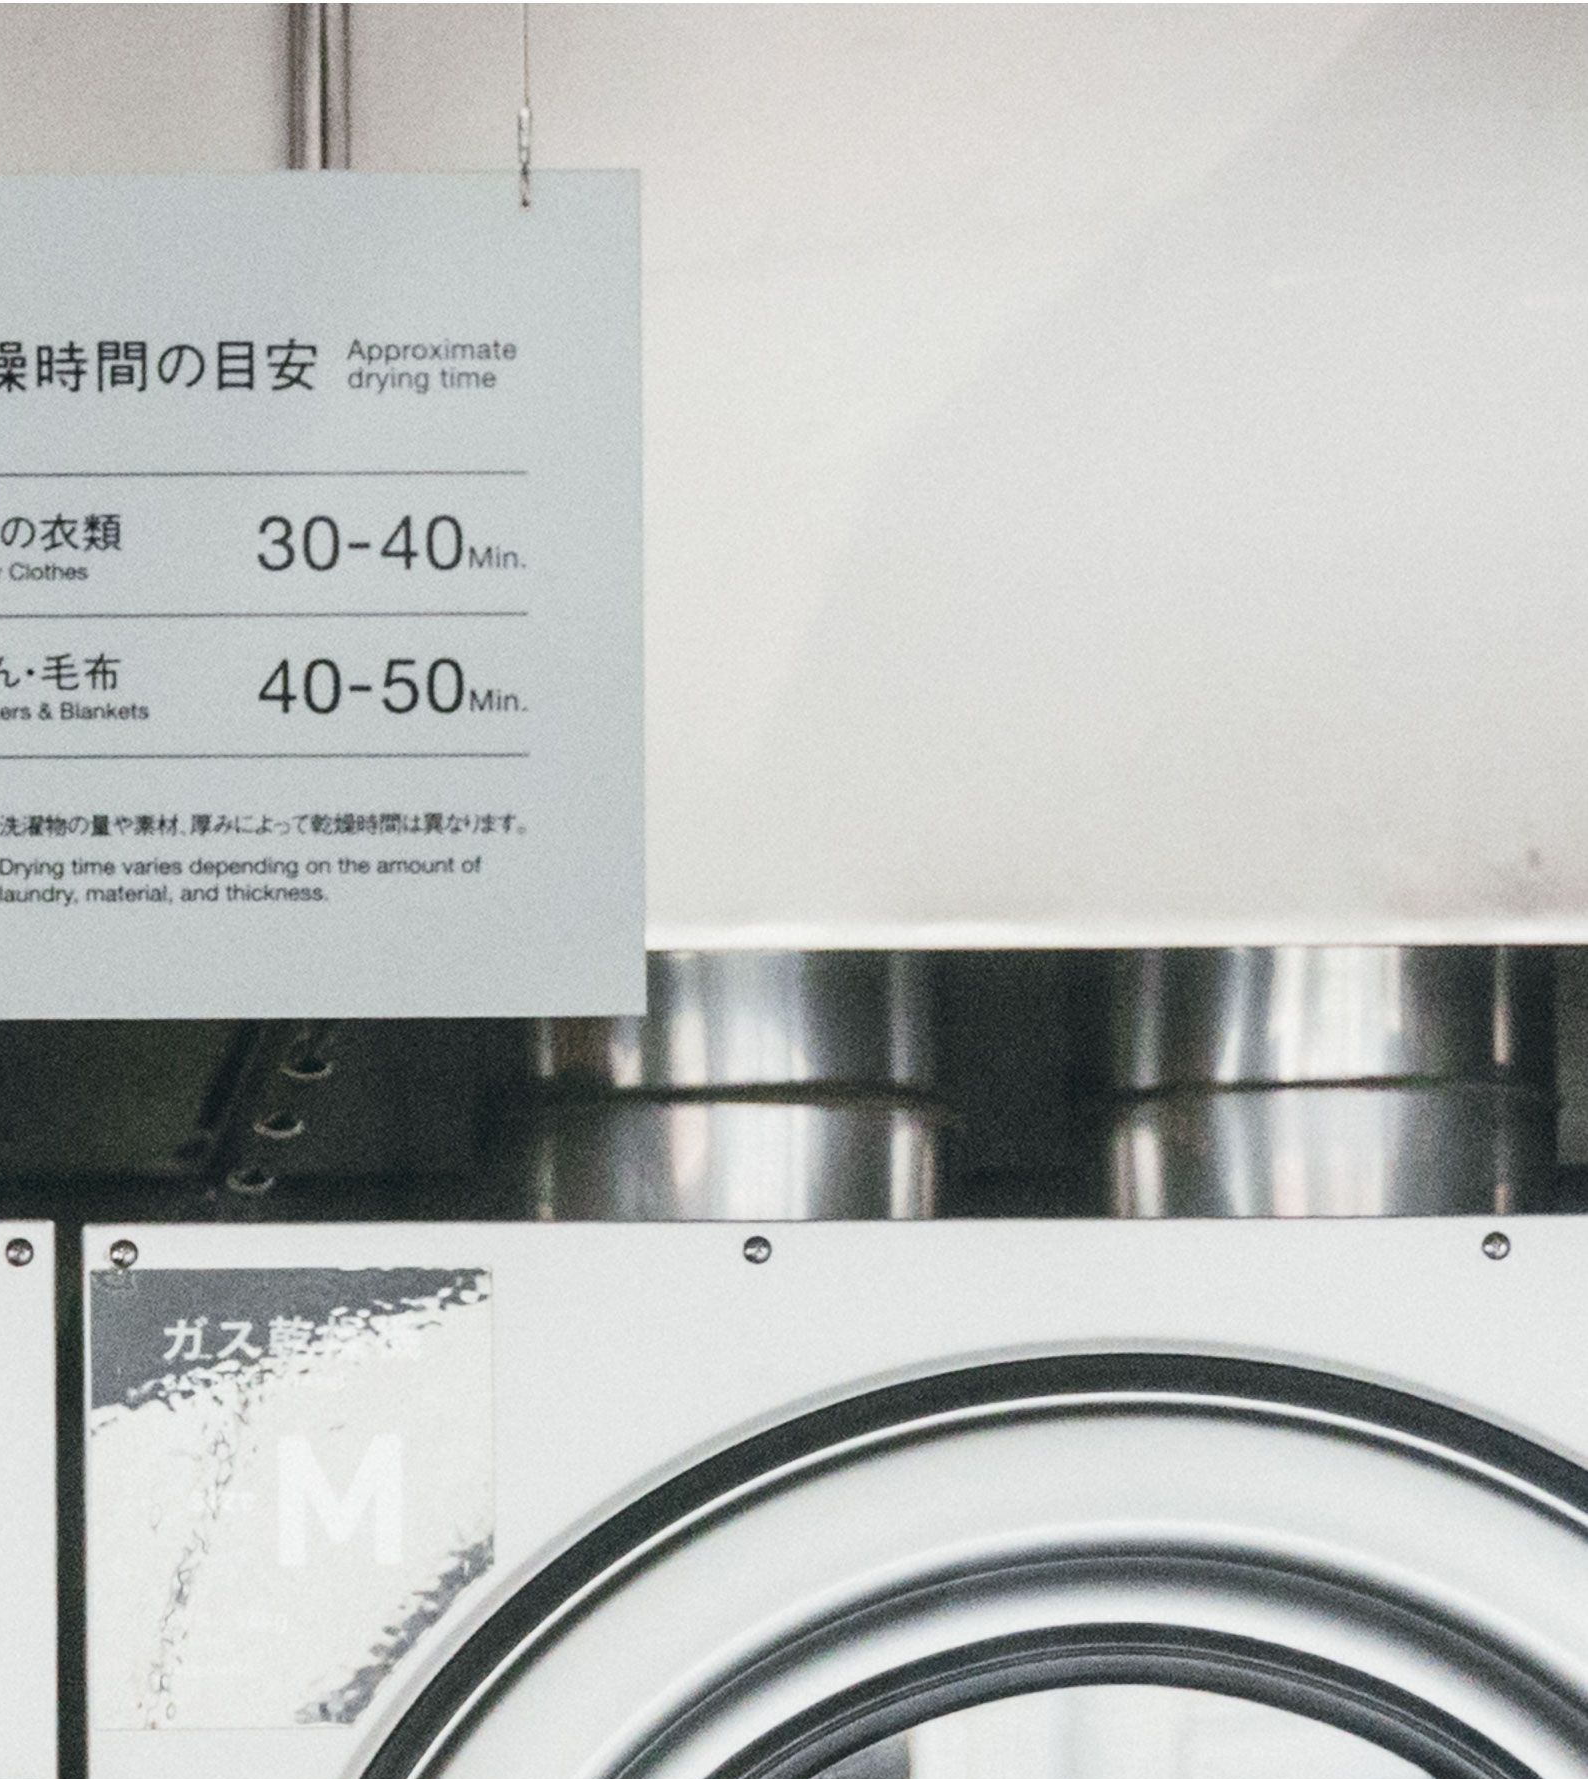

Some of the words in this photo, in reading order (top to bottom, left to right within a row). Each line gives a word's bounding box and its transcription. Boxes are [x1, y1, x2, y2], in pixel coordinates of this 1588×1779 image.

[347, 339, 517, 365] Approximate
[347, 368, 429, 394] drying
[440, 369, 497, 388] time
[9, 562, 88, 581] Clothes
[38, 702, 53, 720] &
[60, 702, 149, 720] Blankets
[0, 858, 65, 880] Drying
[71, 859, 116, 876] time
[122, 861, 183, 875] varies
[189, 858, 299, 879] depending
[306, 861, 331, 874] on
[338, 858, 370, 874] the
[377, 858, 454, 874] amount
[461, 856, 481, 873] of
[0, 886, 78, 906] laundry,
[86, 885, 172, 902] material,
[180, 886, 219, 902] and
[226, 884, 329, 901] thickness.
[277, 1435, 403, 1567] M
